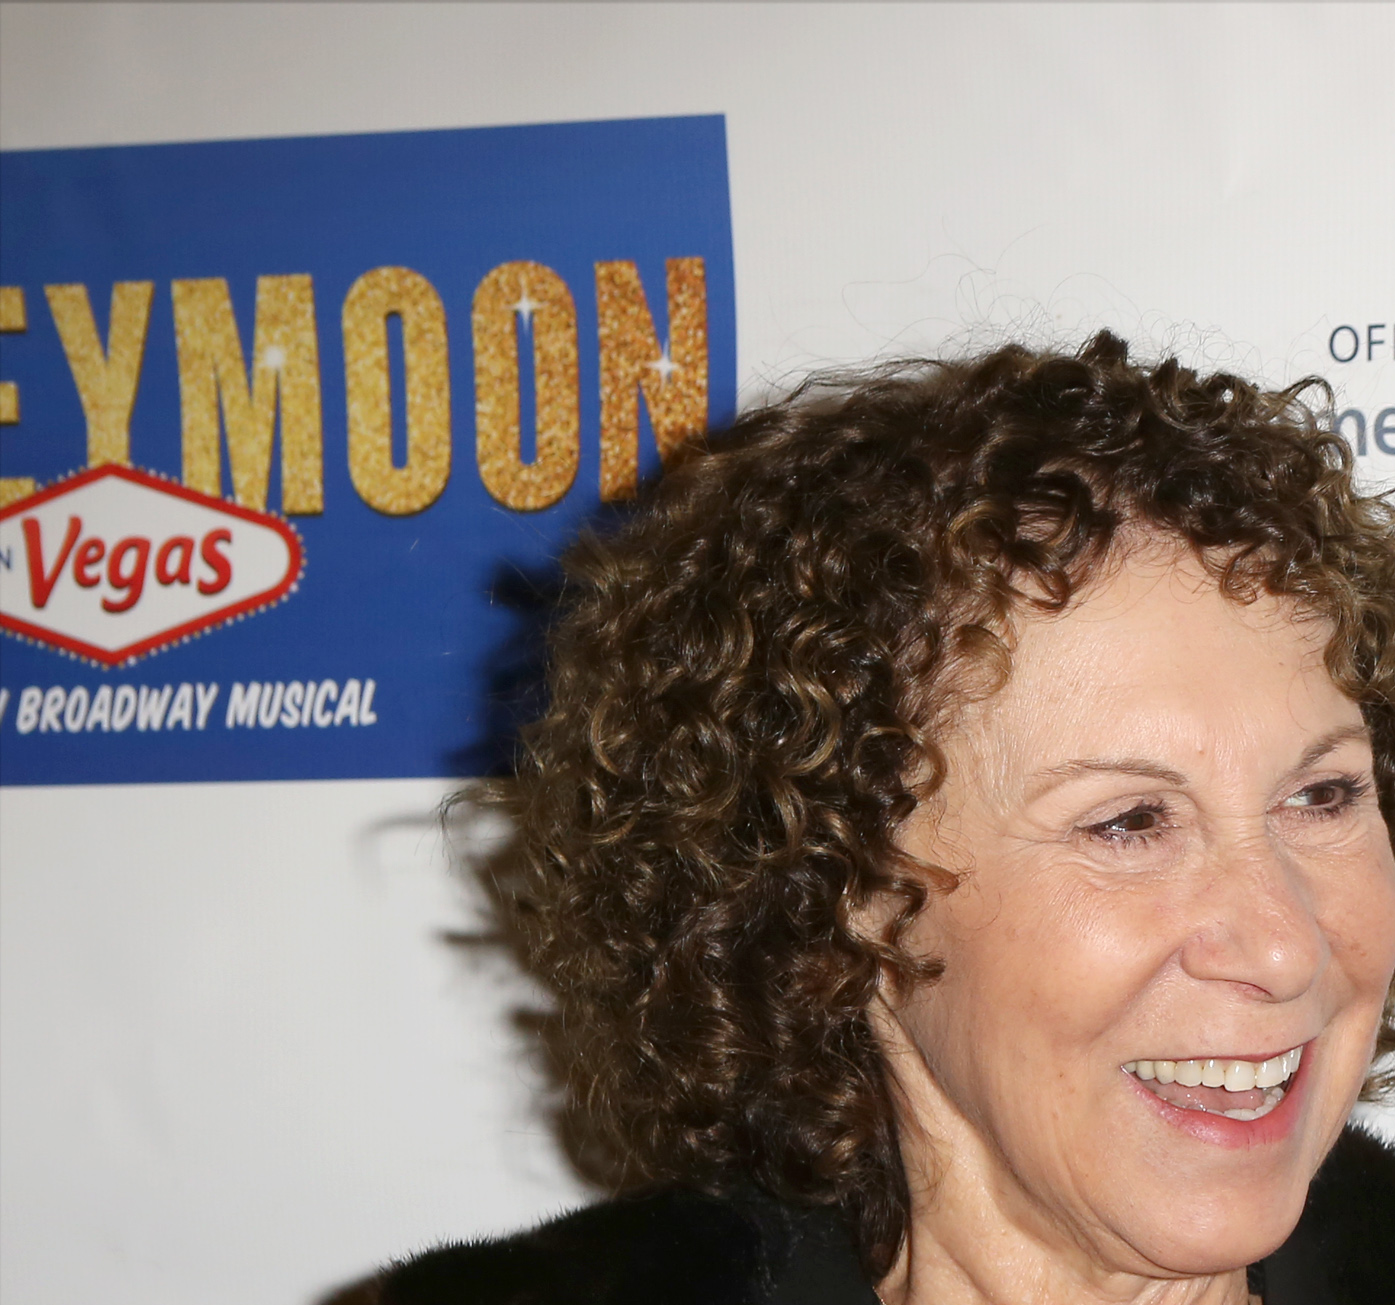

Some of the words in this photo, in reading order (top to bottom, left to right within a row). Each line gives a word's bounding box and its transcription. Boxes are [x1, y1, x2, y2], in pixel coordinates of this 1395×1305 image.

[22, 514, 233, 613] Vegas
[16, 682, 219, 734] BROADWAY
[225, 678, 378, 729] MUSICAL
